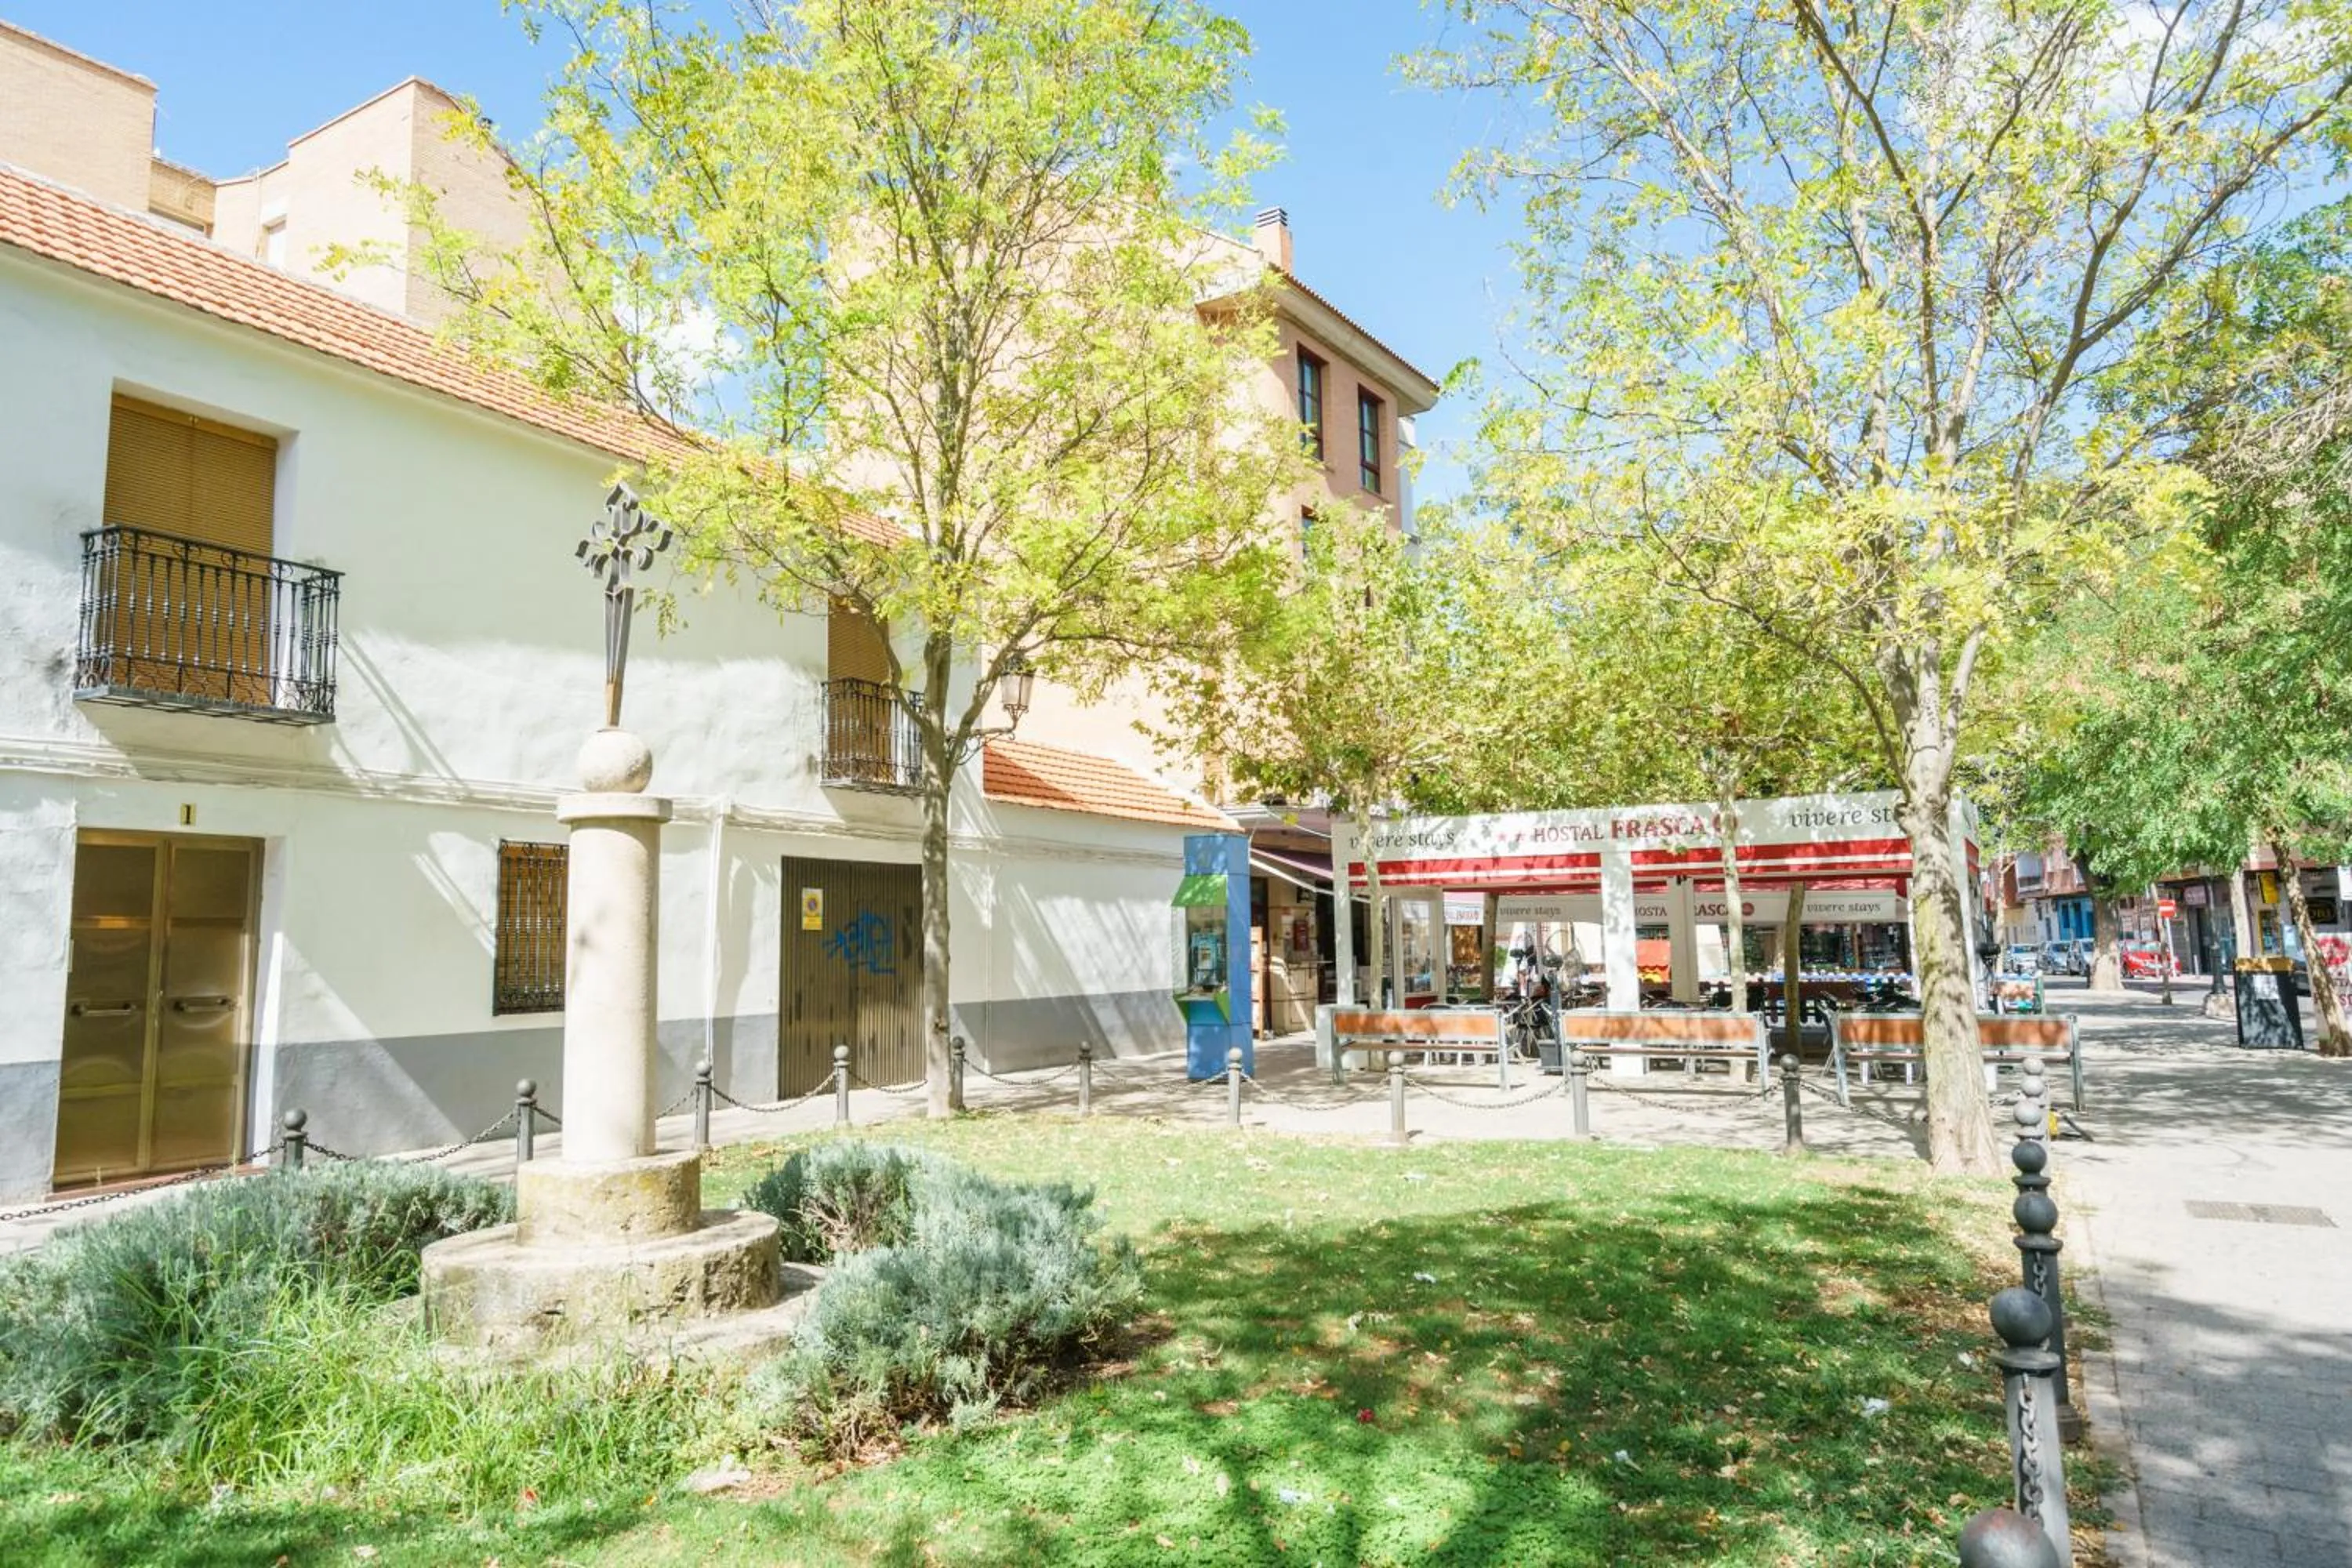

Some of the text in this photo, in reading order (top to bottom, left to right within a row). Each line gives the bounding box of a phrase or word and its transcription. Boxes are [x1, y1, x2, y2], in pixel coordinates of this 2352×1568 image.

[1791, 807, 1862, 828] vivere
[1534, 815, 1707, 843] HOSTAL FRASCA
[1349, 831, 1455, 851] vere stays
[1534, 906, 1561, 918] stays
[1849, 902, 1882, 914] stays
